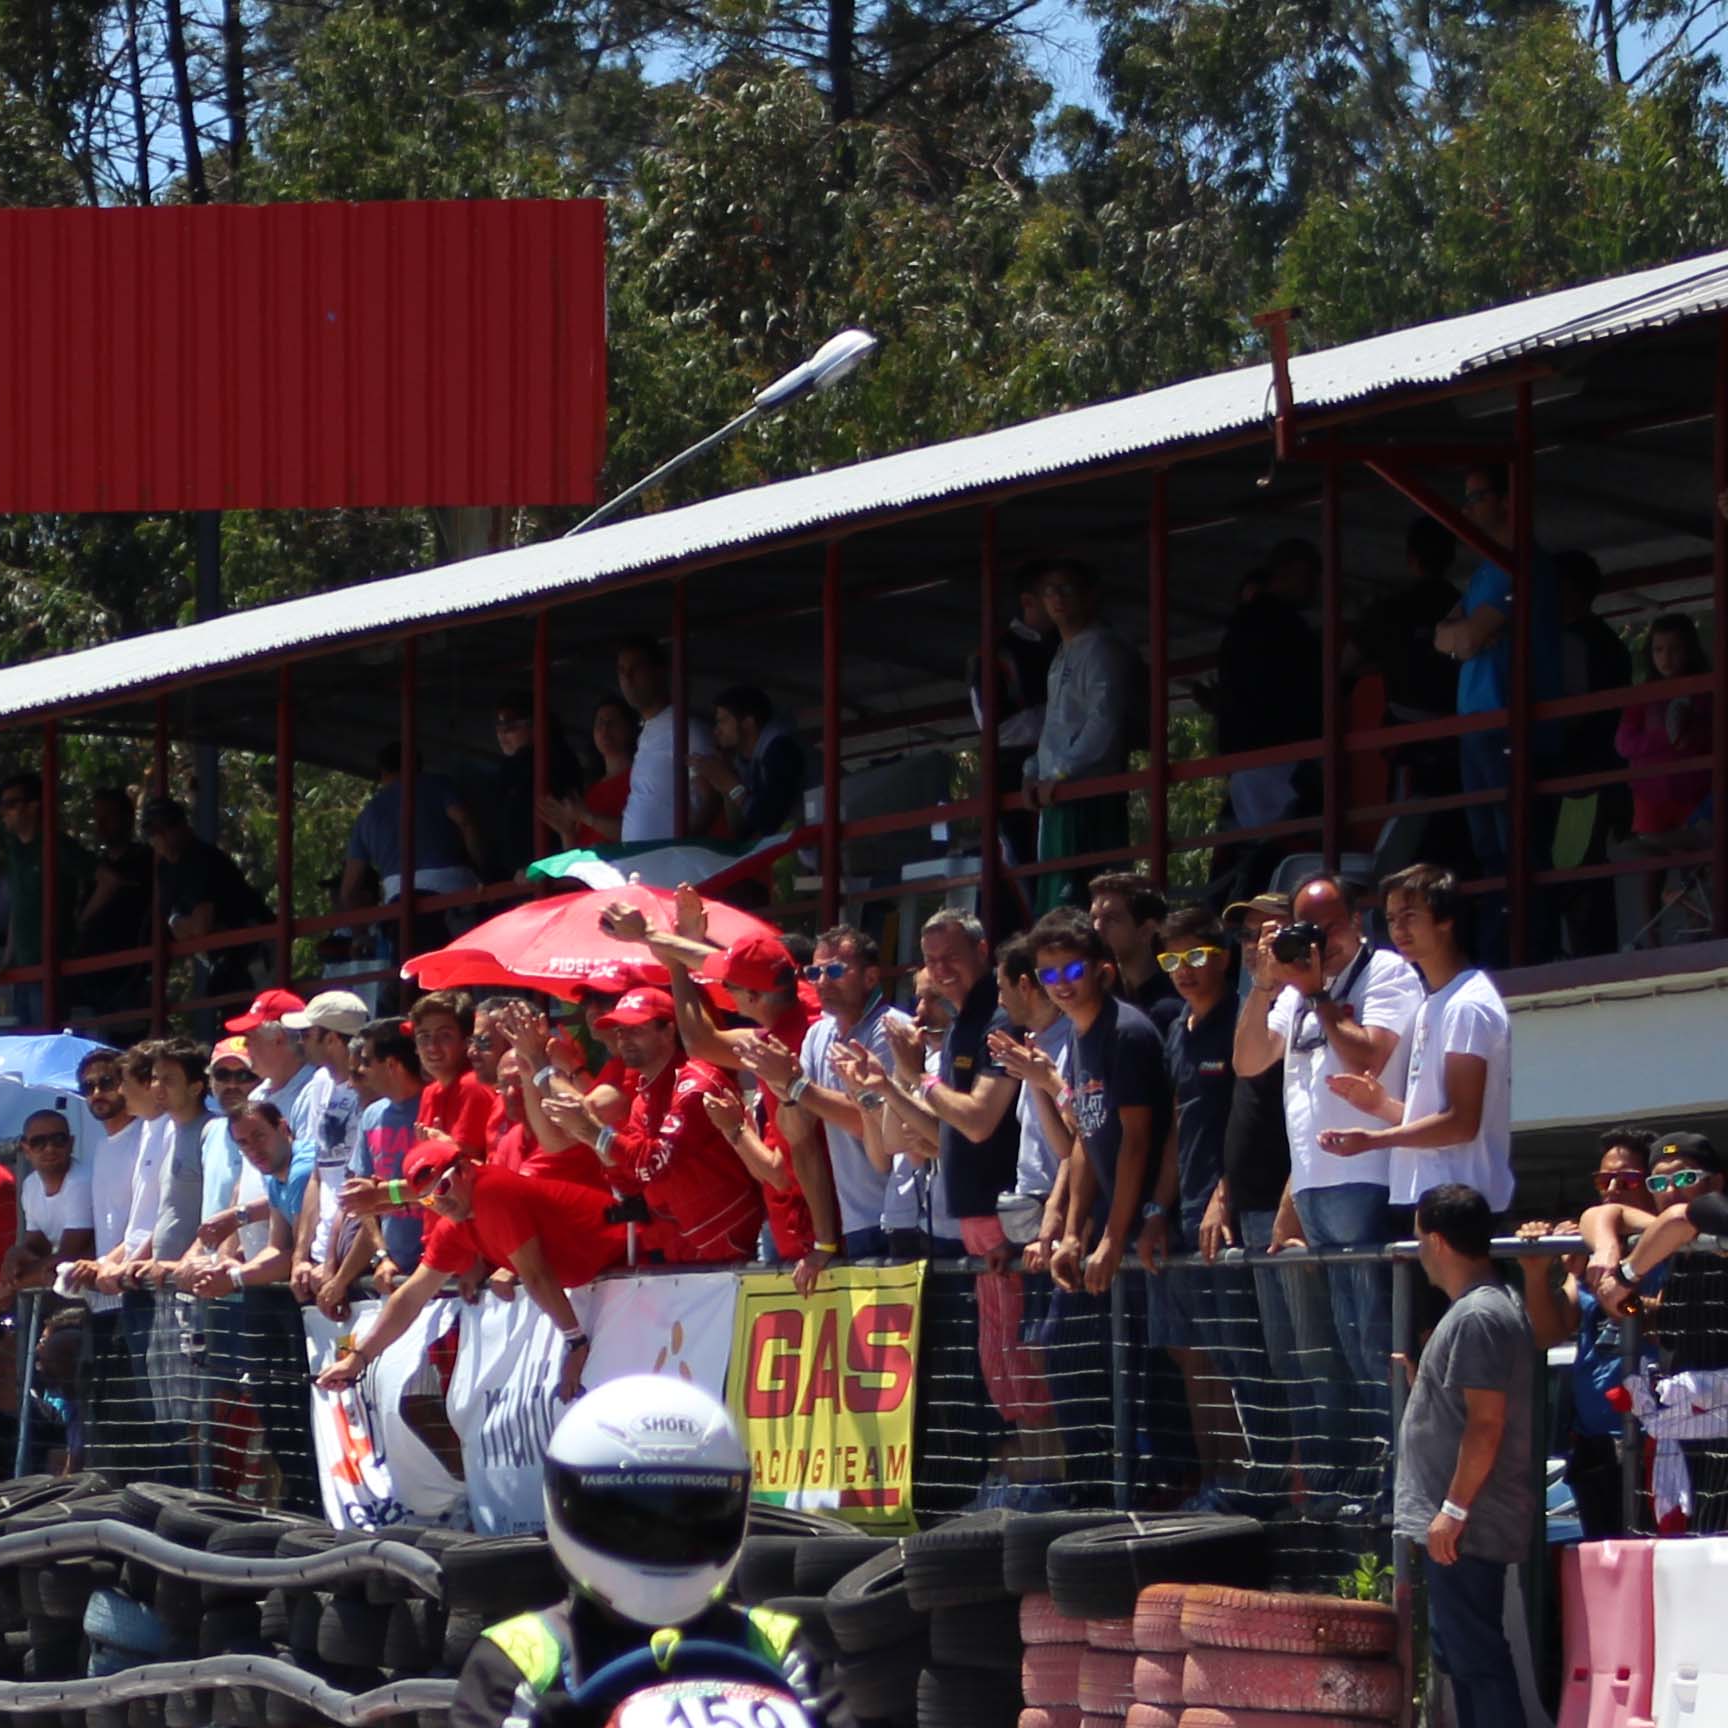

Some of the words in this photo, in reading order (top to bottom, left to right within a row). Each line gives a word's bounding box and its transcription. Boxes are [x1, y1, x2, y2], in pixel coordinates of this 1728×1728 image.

[746, 1304, 914, 1419] GAS
[640, 1416, 695, 1434] SHOEI
[752, 1449, 825, 1486] ACING
[832, 1445, 907, 1484] TEAM
